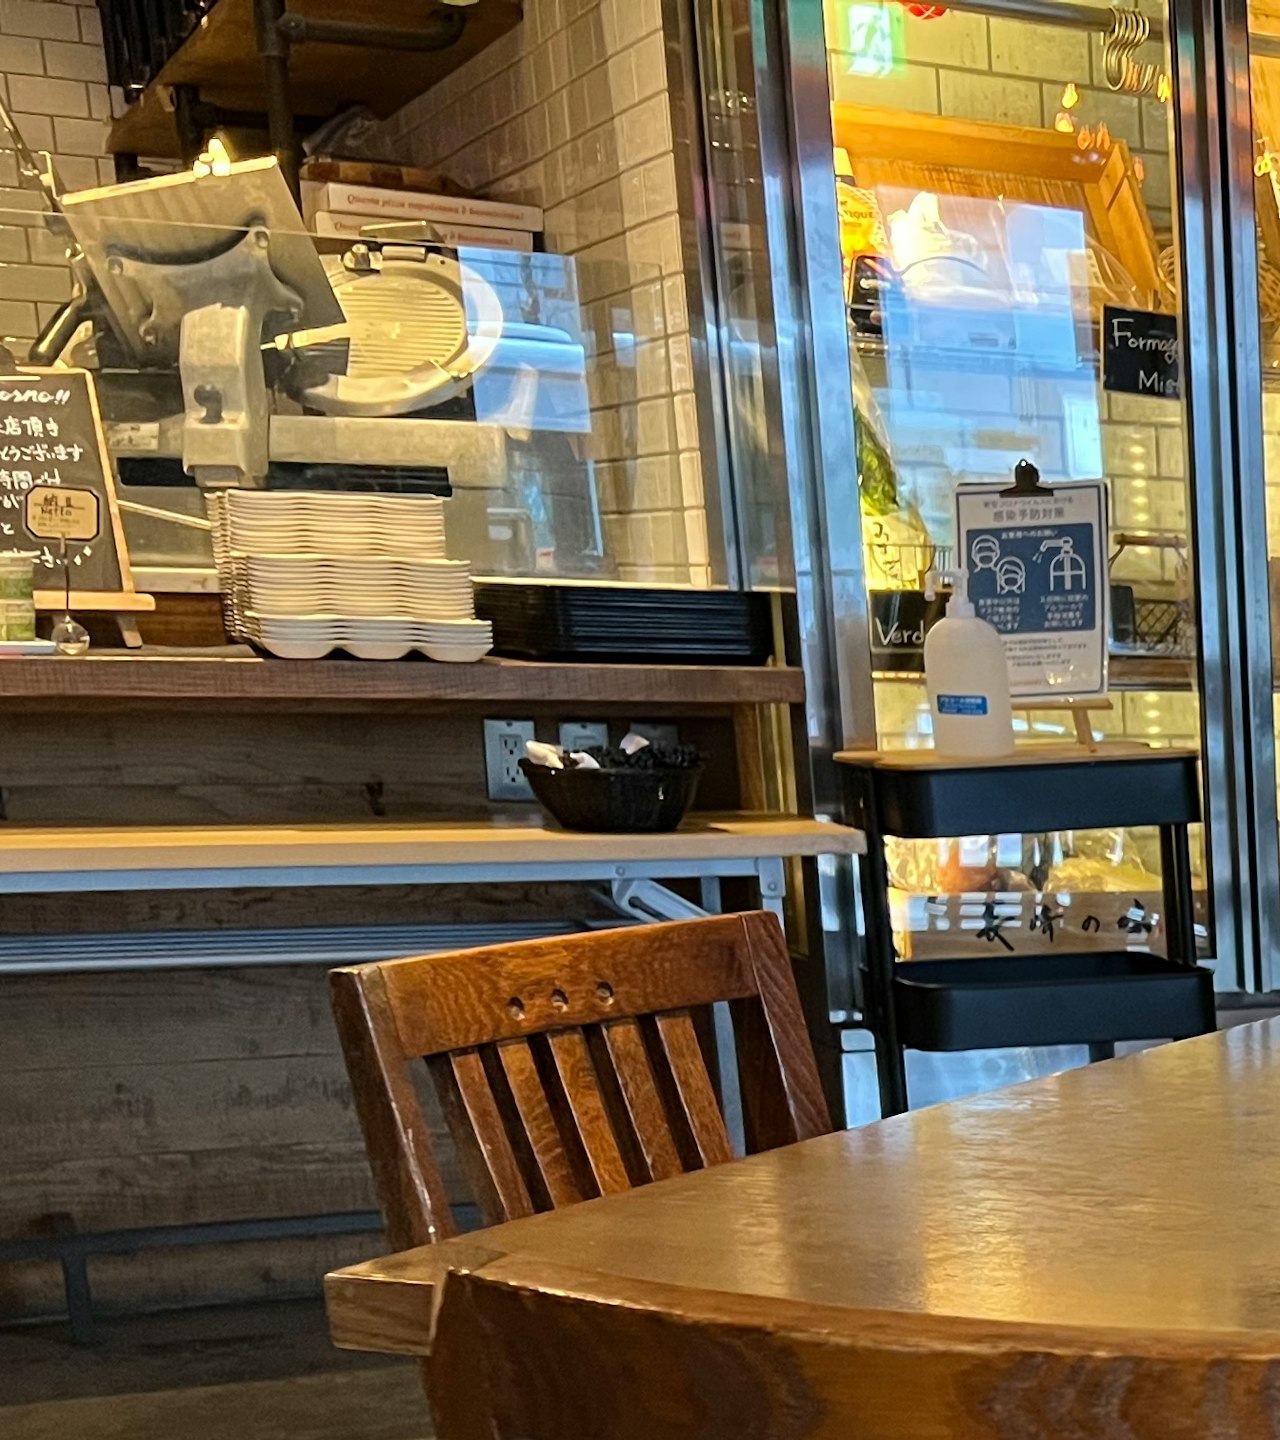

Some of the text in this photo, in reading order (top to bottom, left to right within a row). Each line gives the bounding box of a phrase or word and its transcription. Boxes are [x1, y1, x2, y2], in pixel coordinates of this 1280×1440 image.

[992, 508, 1065, 522] 感染予防対策
